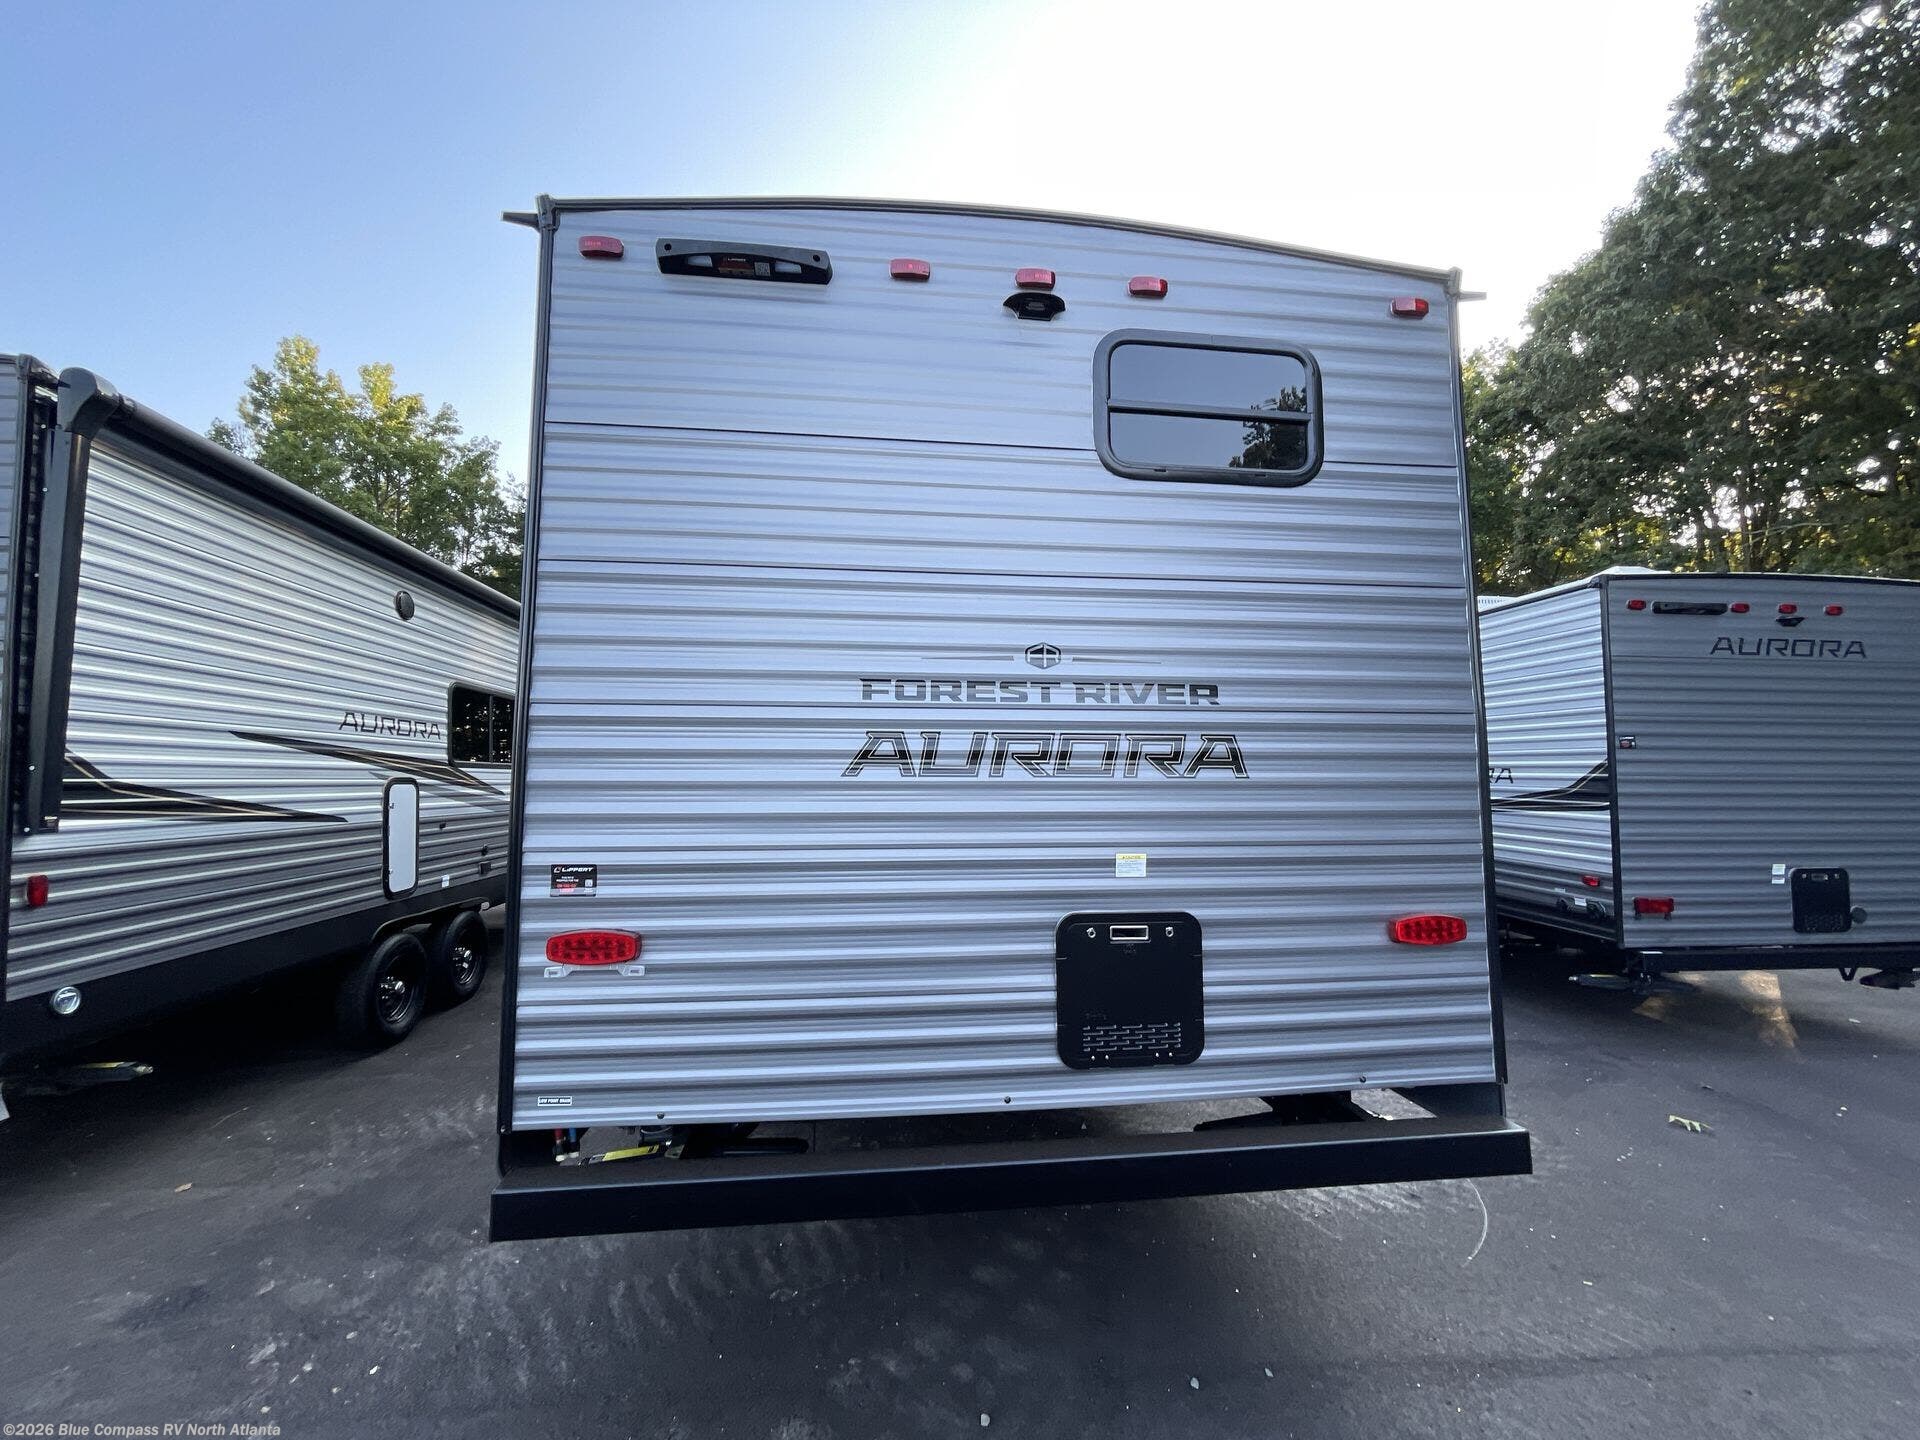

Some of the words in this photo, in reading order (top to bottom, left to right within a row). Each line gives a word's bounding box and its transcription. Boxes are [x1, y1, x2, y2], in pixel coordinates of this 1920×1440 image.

[1710, 636, 1868, 659] AURORA
[859, 678, 1063, 704] FOREST
[1072, 680, 1220, 706] RIVER
[339, 711, 441, 740] AURORA
[841, 730, 1250, 779] AURORA
